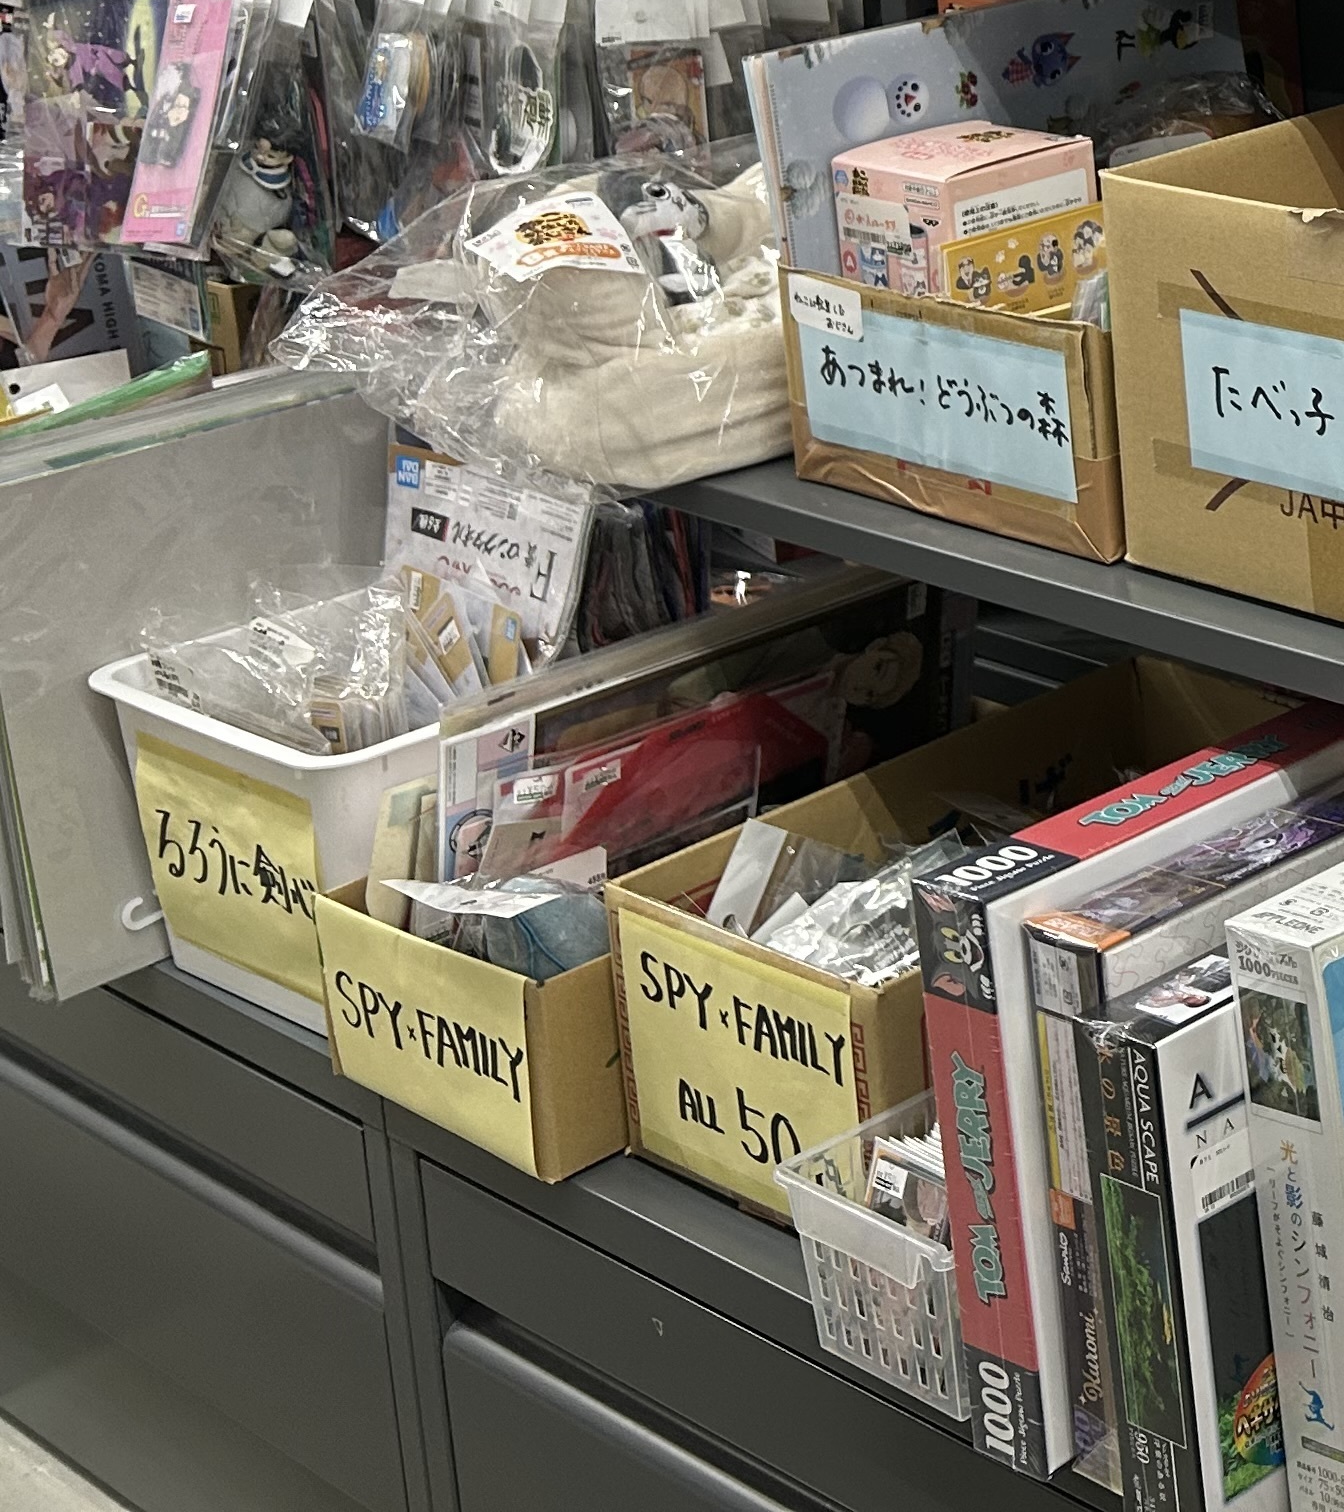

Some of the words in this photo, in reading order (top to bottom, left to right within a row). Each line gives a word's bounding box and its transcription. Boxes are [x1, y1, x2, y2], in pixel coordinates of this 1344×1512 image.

[1079, 792, 1167, 828] TOM
[936, 844, 1040, 890] 1000
[1239, 954, 1273, 978] 1000
[678, 1077, 727, 1136] ALL
[1132, 1048, 1152, 1113] AQUA
[951, 1051, 996, 1192] JERRY
[1139, 1117, 1160, 1185] SCAPE
[968, 1223, 1007, 1305] TOM
[1058, 1231, 1072, 1287] Sanrio
[1279, 1139, 1319, 1380] 光と影のシンフォニー
[1310, 1210, 1334, 1324] 藤城清治
[1081, 1314, 1104, 1403] Kuromi
[978, 1361, 1016, 1459] 1000
[1134, 1432, 1150, 1464] 950
